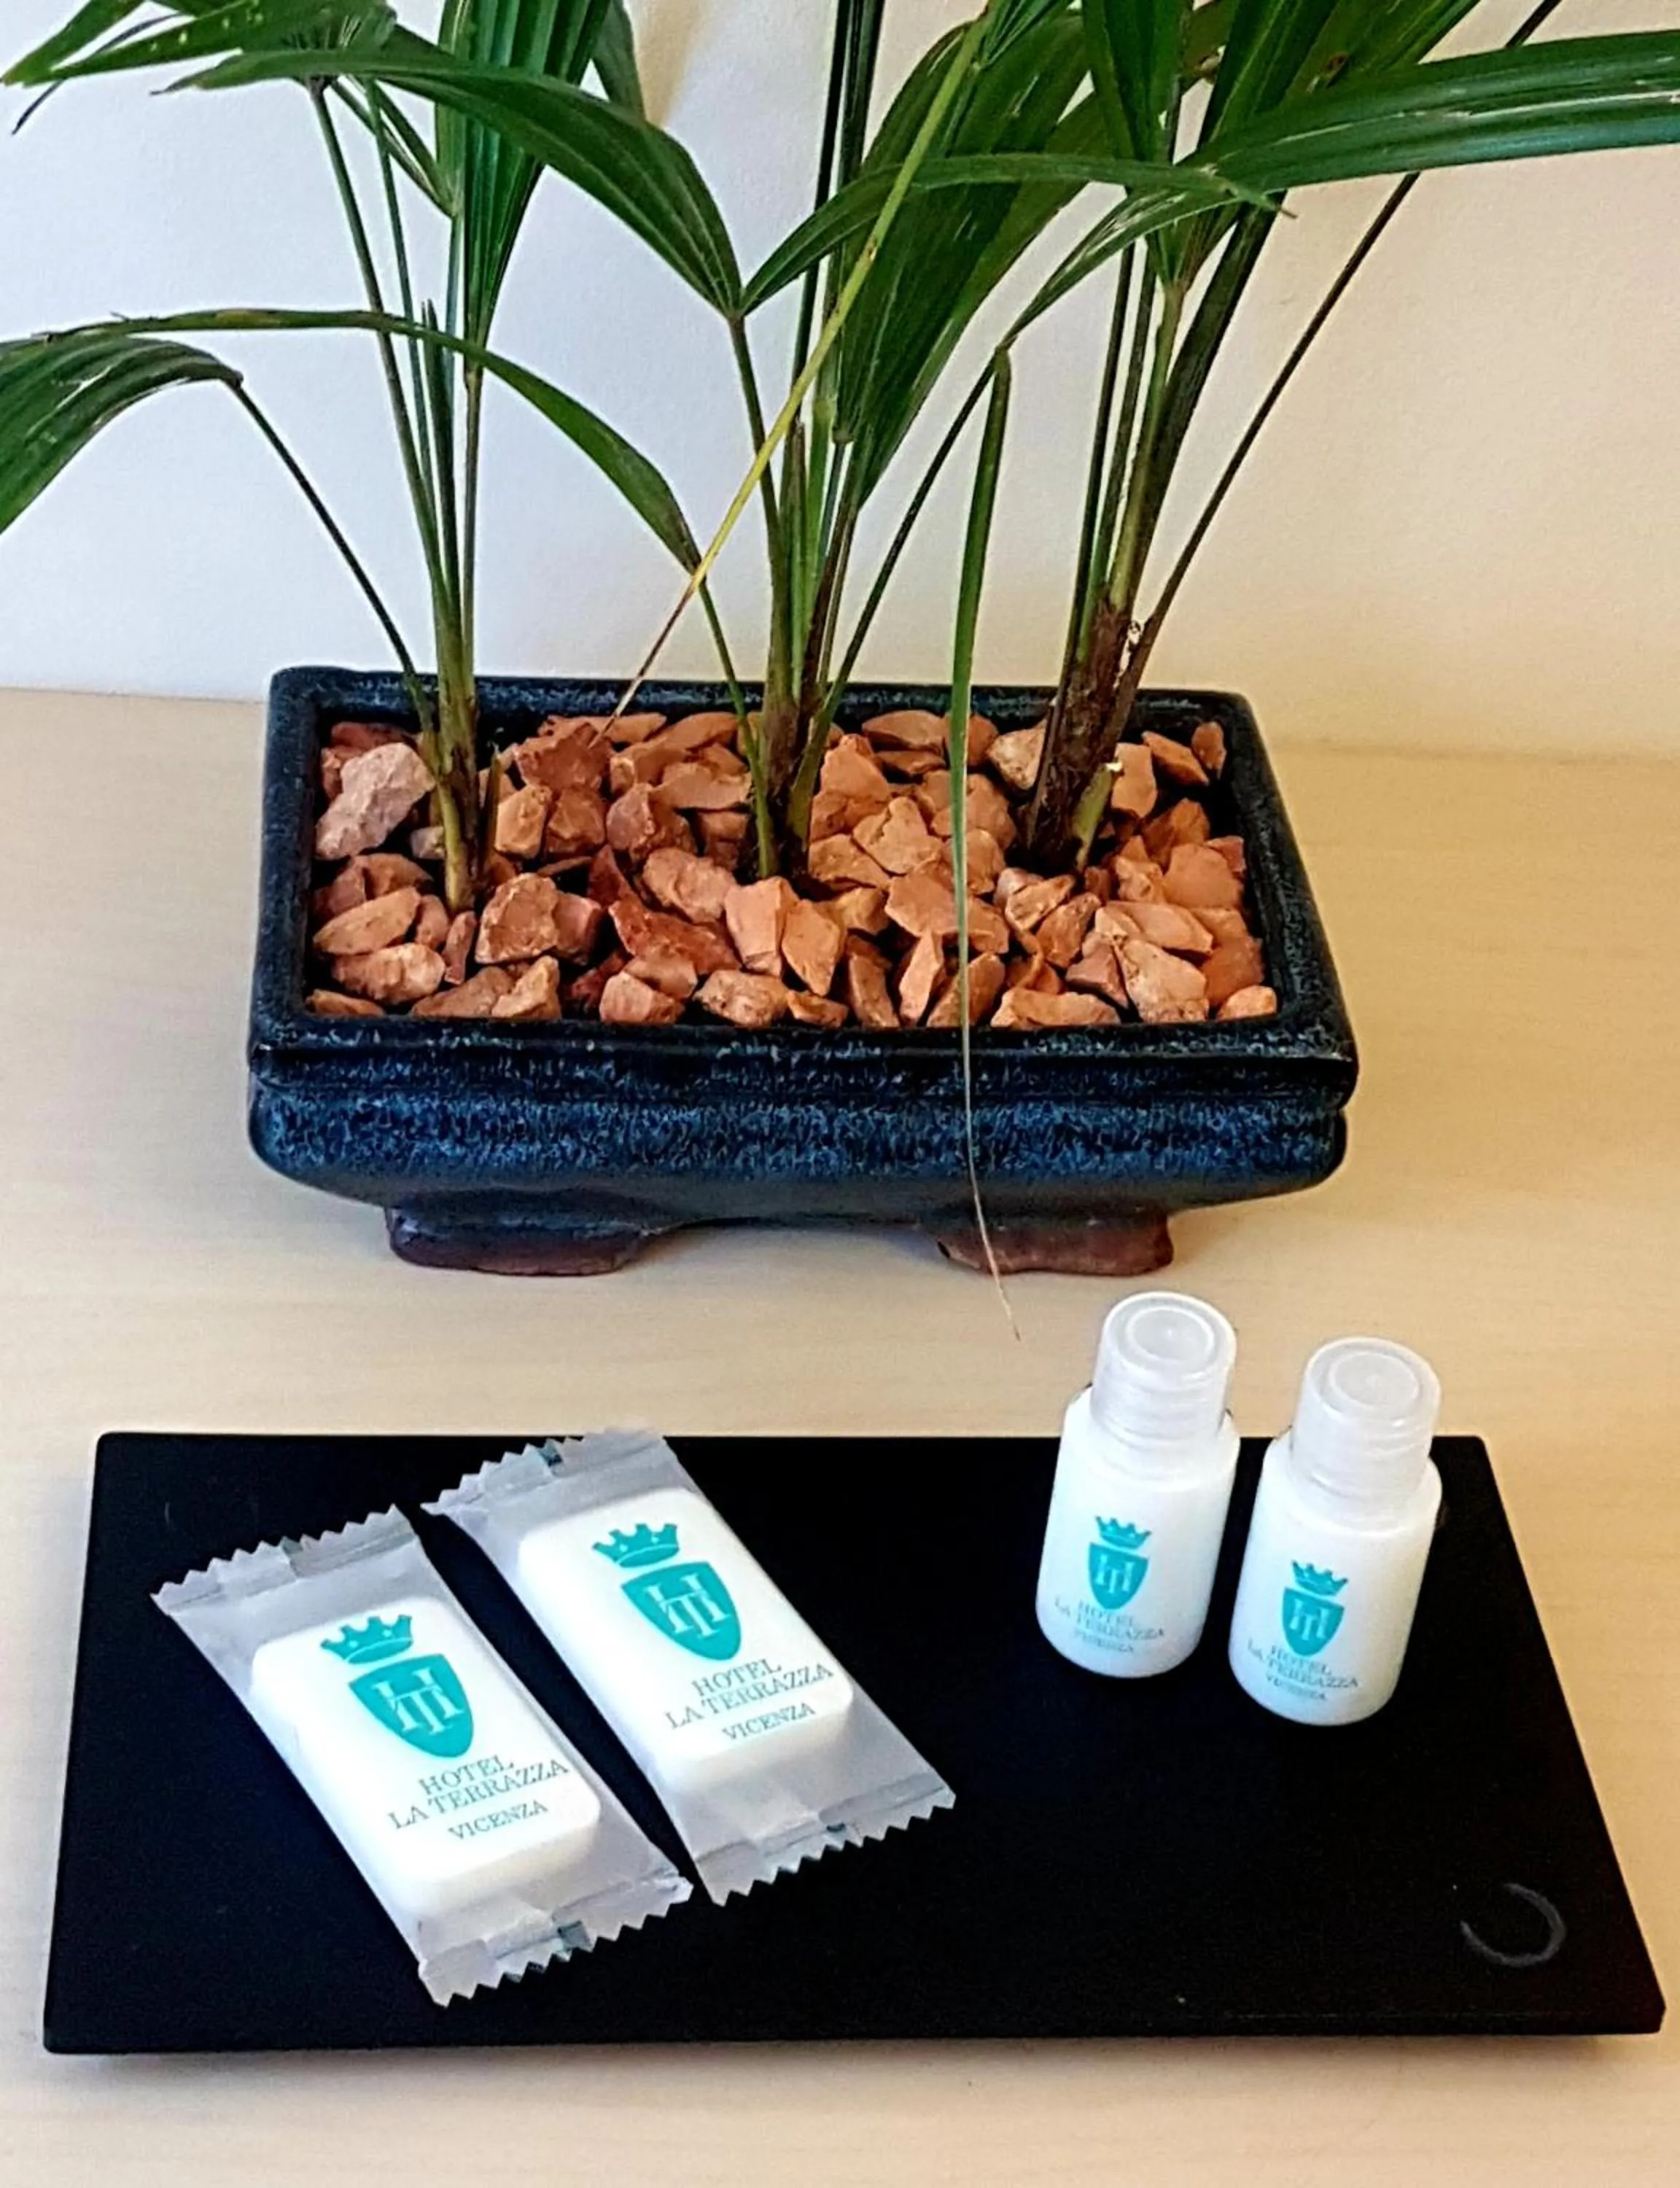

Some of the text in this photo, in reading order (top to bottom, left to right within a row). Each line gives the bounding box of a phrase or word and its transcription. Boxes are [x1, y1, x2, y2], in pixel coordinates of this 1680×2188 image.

[664, 1663, 834, 1729] LA TERRAZZA
[691, 1658, 782, 1697] HOTEL
[721, 1702, 816, 1740] VICENZA
[388, 1758, 569, 1831] LA TERRAZZA
[418, 1754, 514, 1796] HOTEL
[448, 1799, 548, 1841] VICENZA
